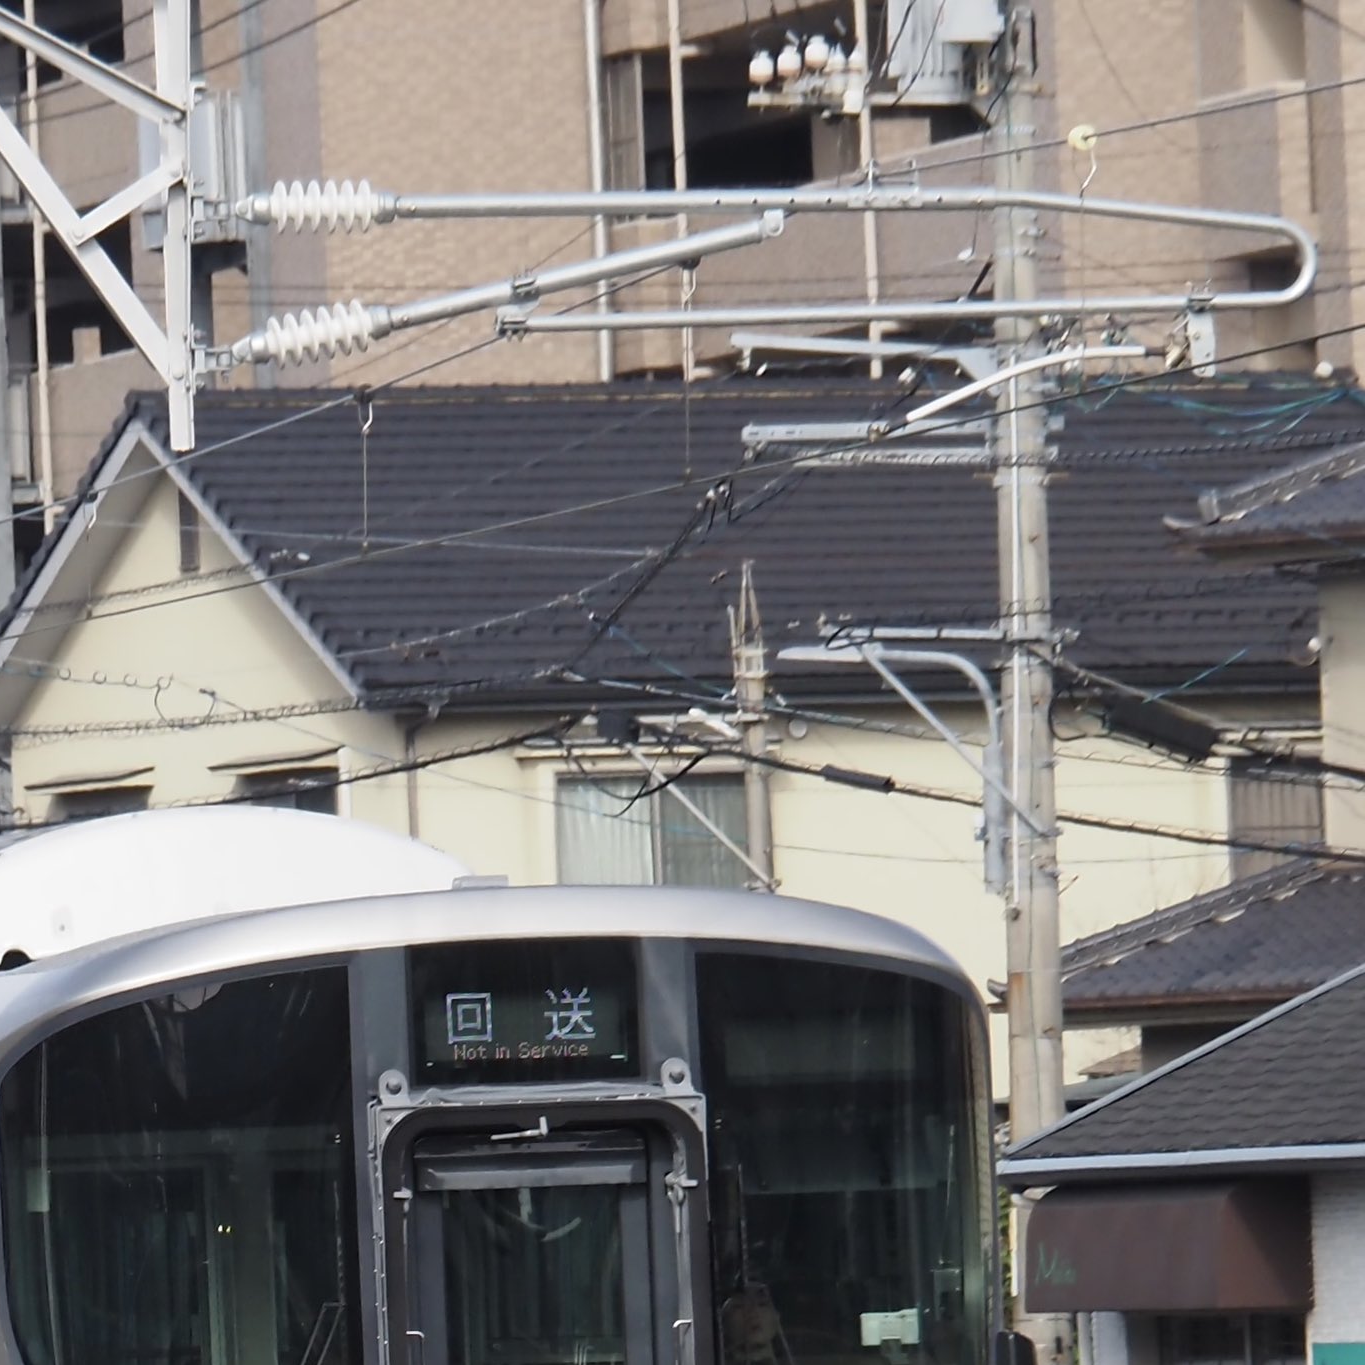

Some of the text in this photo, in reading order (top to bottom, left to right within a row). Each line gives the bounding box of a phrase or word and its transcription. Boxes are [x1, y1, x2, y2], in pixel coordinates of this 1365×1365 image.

[446, 987, 595, 1043] 回送
[454, 1041, 589, 1060] Not in Service
